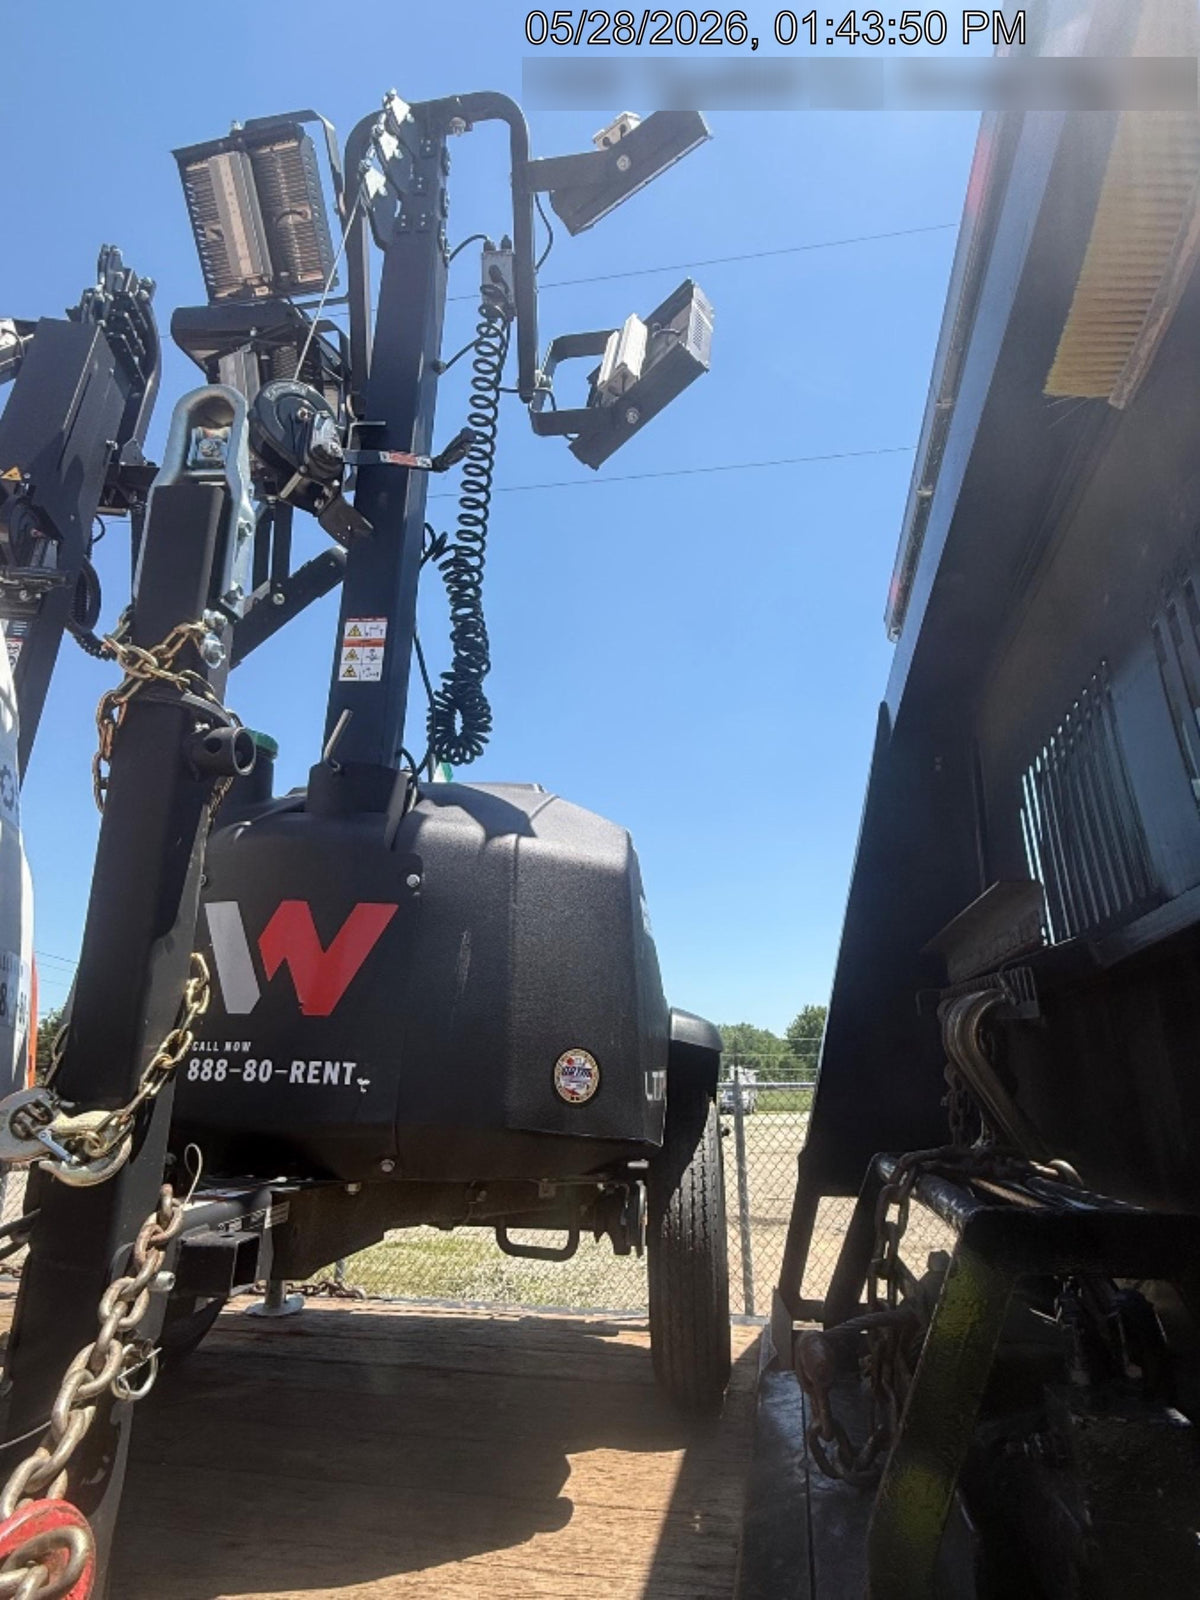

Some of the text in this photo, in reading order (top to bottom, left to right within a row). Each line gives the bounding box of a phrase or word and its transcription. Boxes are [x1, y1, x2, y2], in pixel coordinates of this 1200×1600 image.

[191, 1041, 252, 1052] CALL NOW
[187, 1058, 357, 1086] 888-80-RENT
